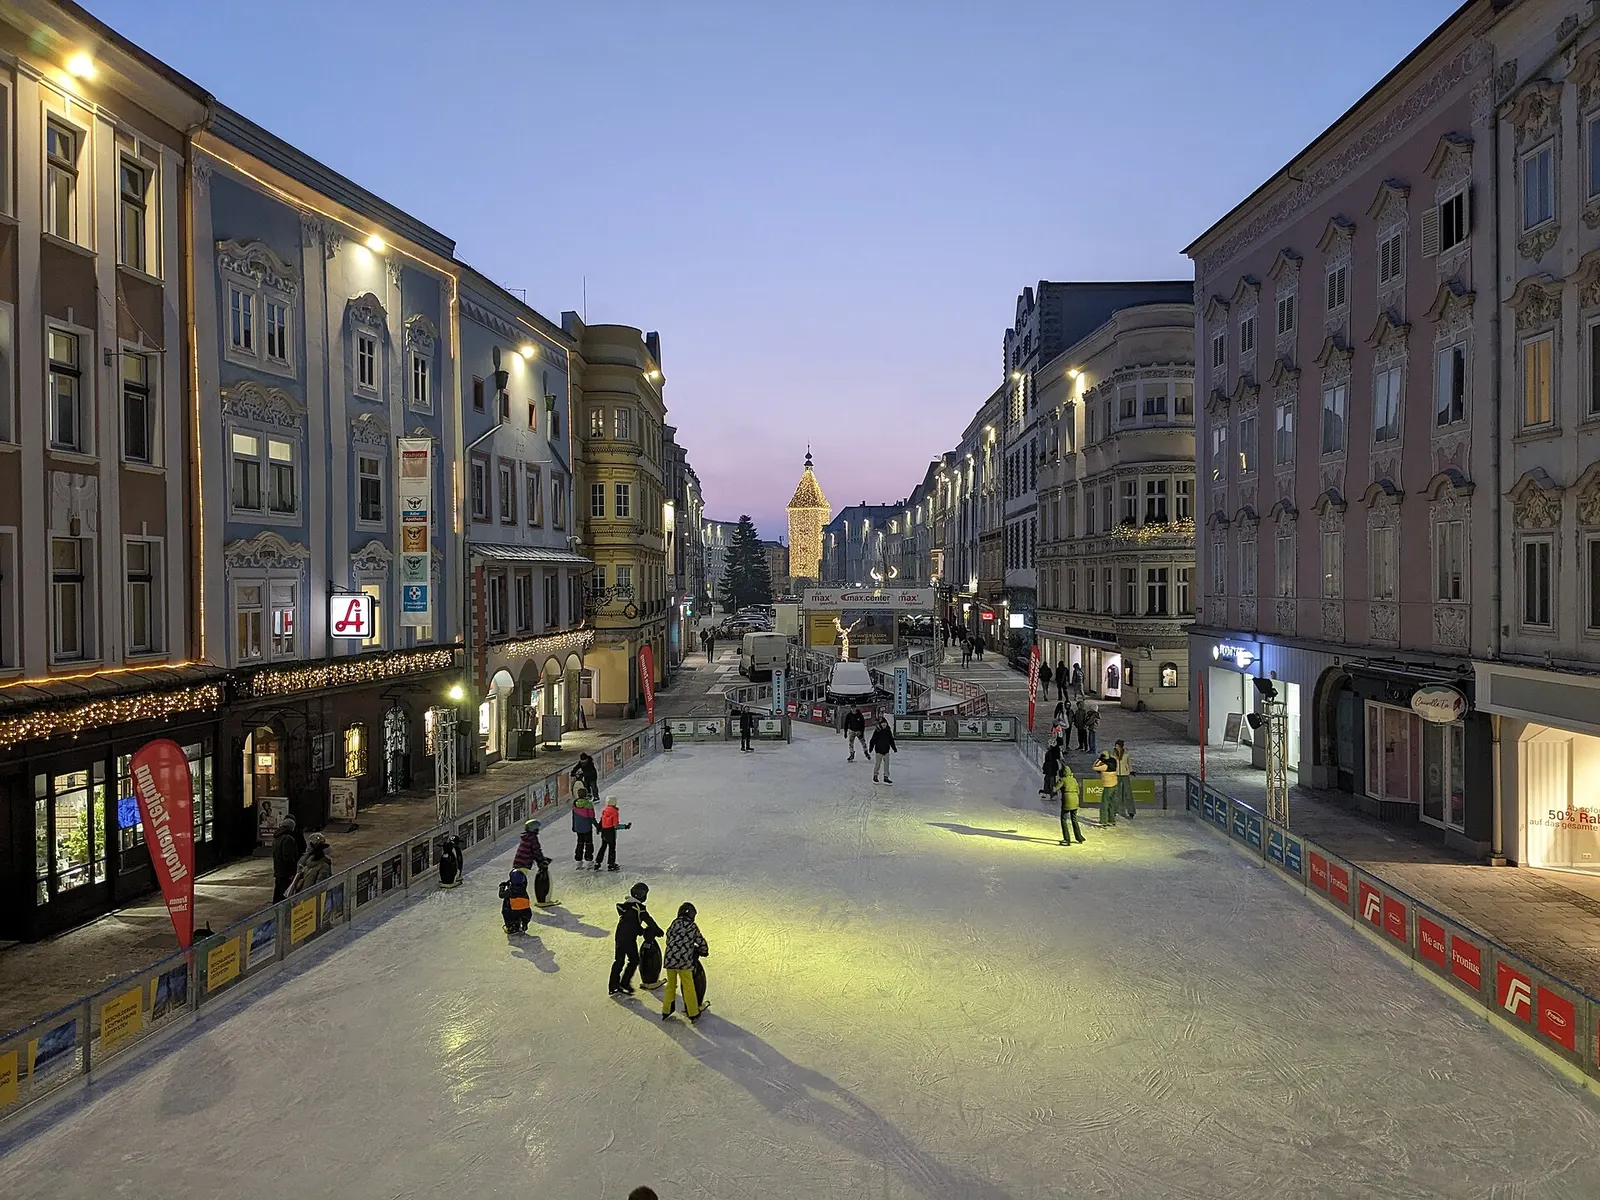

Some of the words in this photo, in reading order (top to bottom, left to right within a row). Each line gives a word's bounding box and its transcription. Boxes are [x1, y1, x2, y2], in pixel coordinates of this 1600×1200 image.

[1548, 809, 1576, 822] 50%
[1561, 822, 1599, 832] gesamte
[1421, 930, 1433, 946] We
[1433, 939, 1445, 953] are
[1452, 949, 1481, 976] Fronius.
